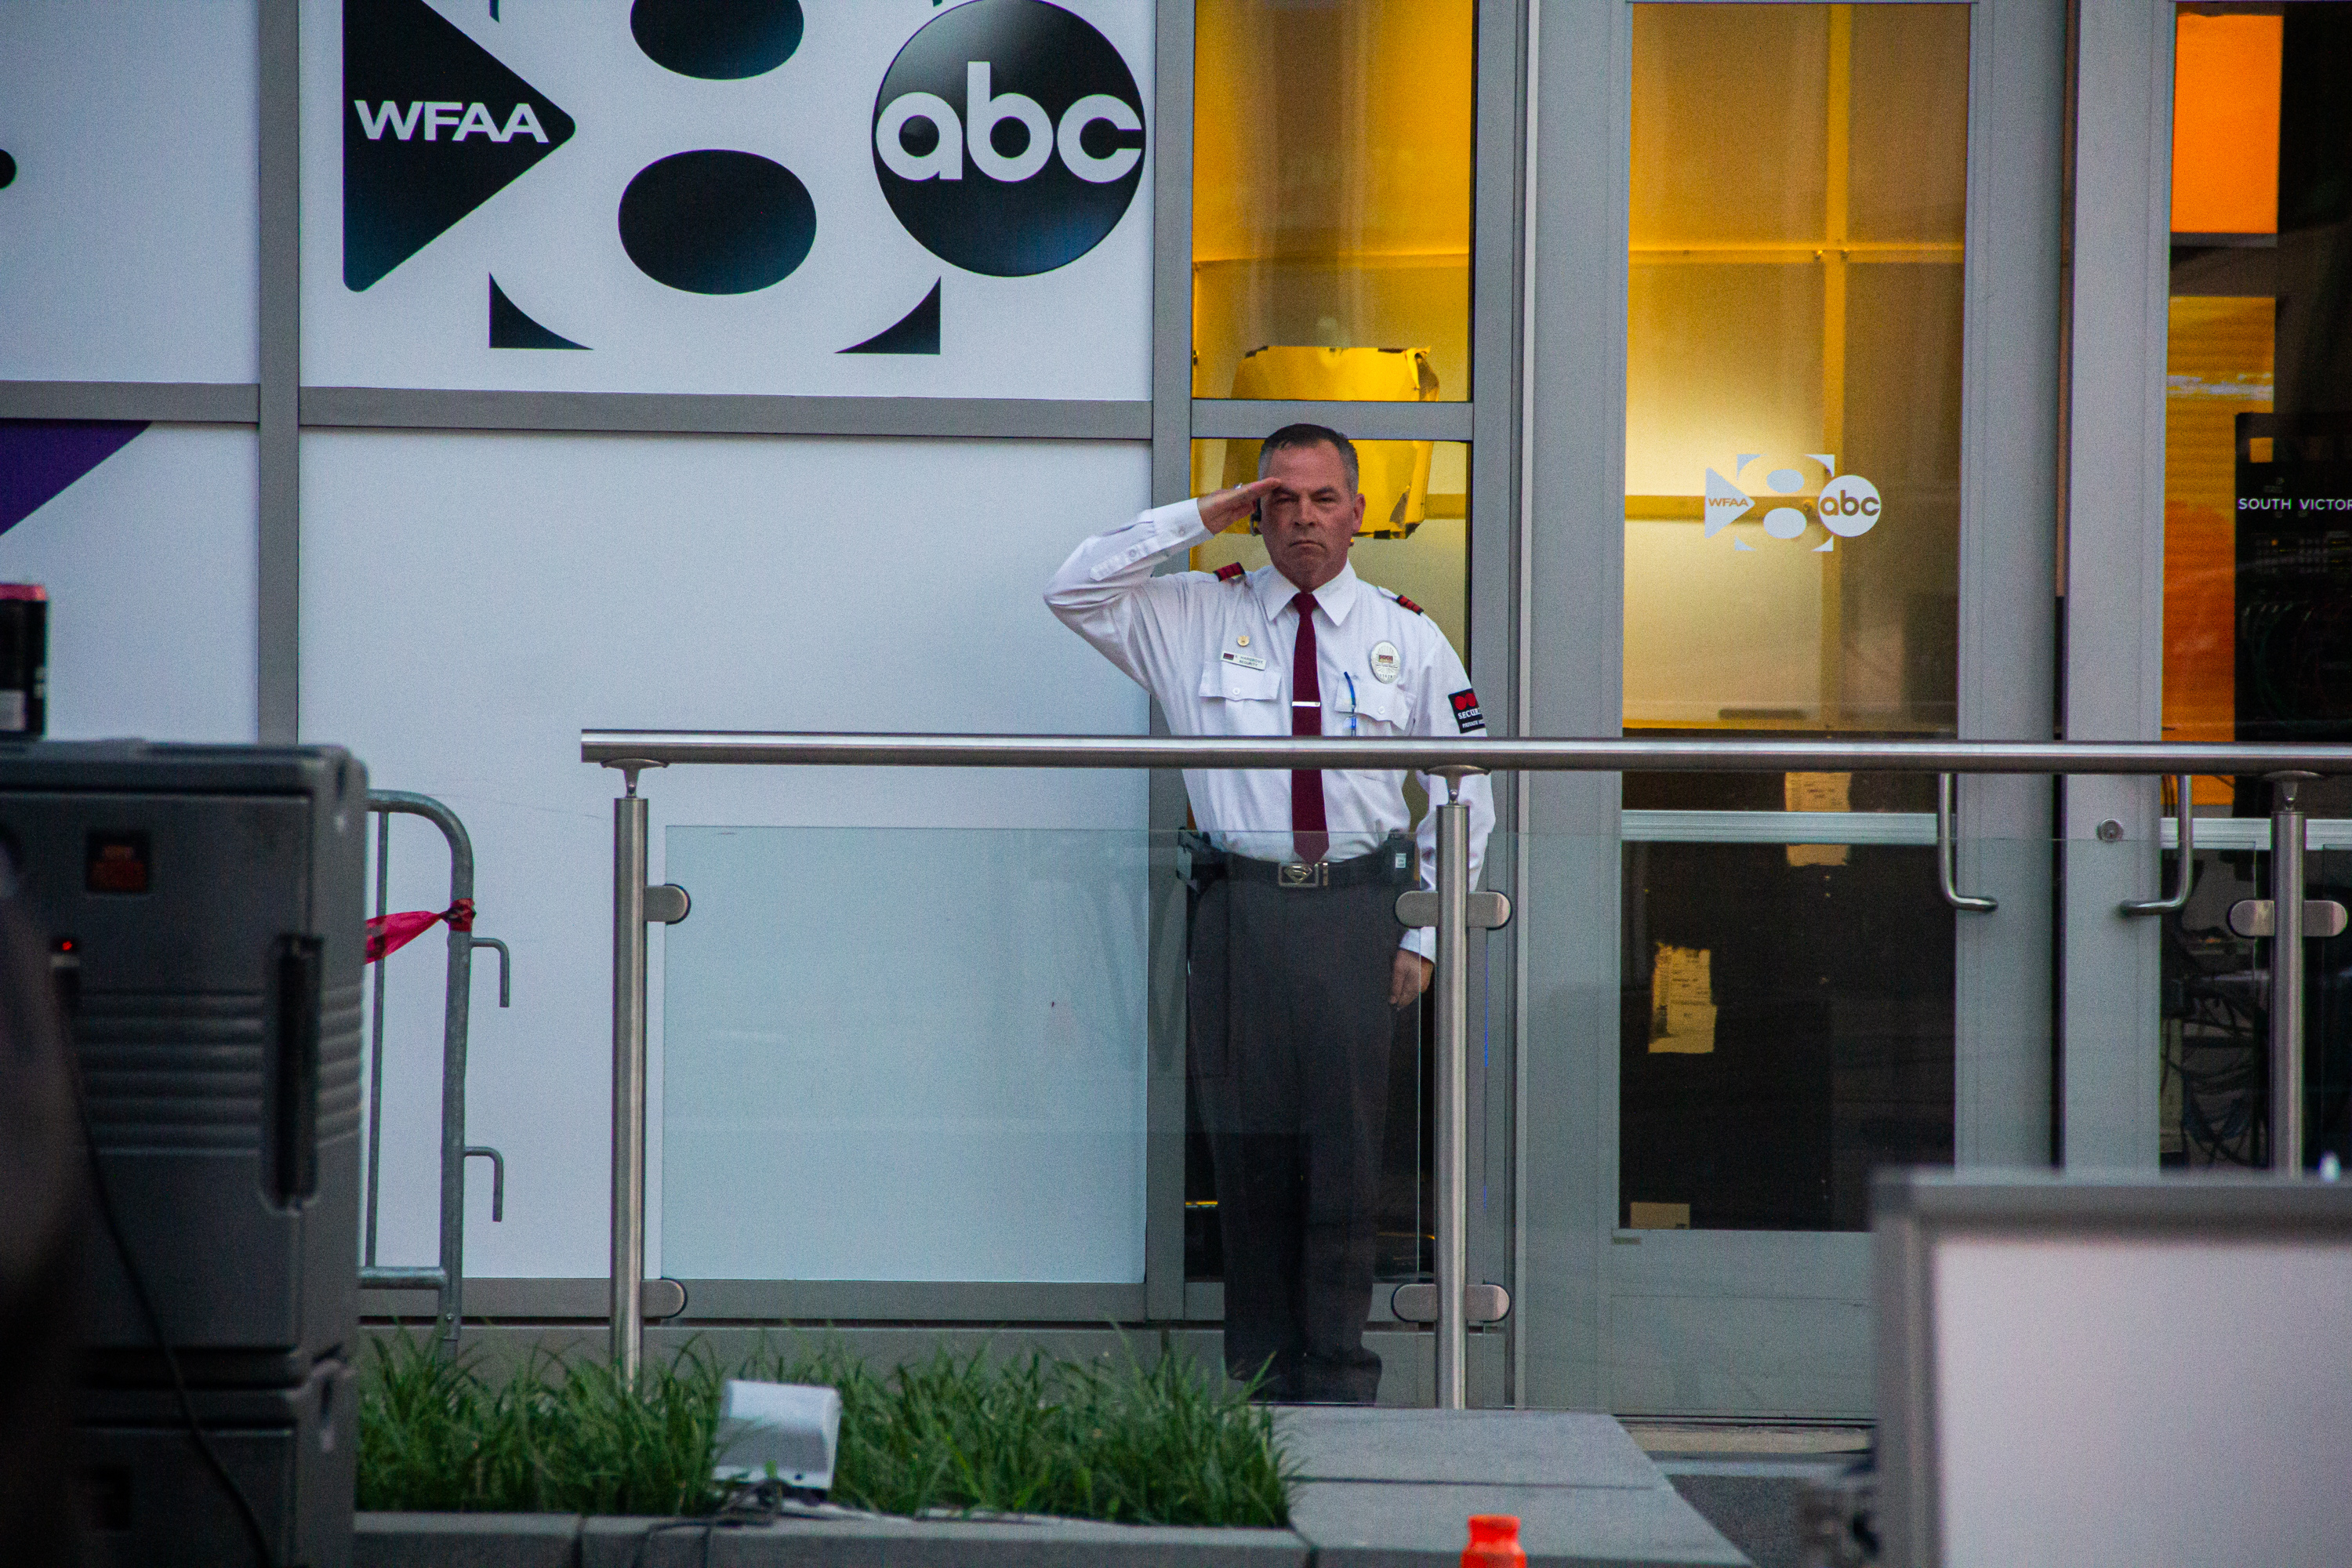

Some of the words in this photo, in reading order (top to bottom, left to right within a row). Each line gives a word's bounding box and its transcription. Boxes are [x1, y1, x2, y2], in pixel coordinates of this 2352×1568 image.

[354, 100, 550, 143] WFAA
[876, 60, 1143, 183] abc
[1708, 498, 1749, 507] WFAA
[1820, 489, 1880, 516] abc
[2238, 498, 2292, 510] SOUTH
